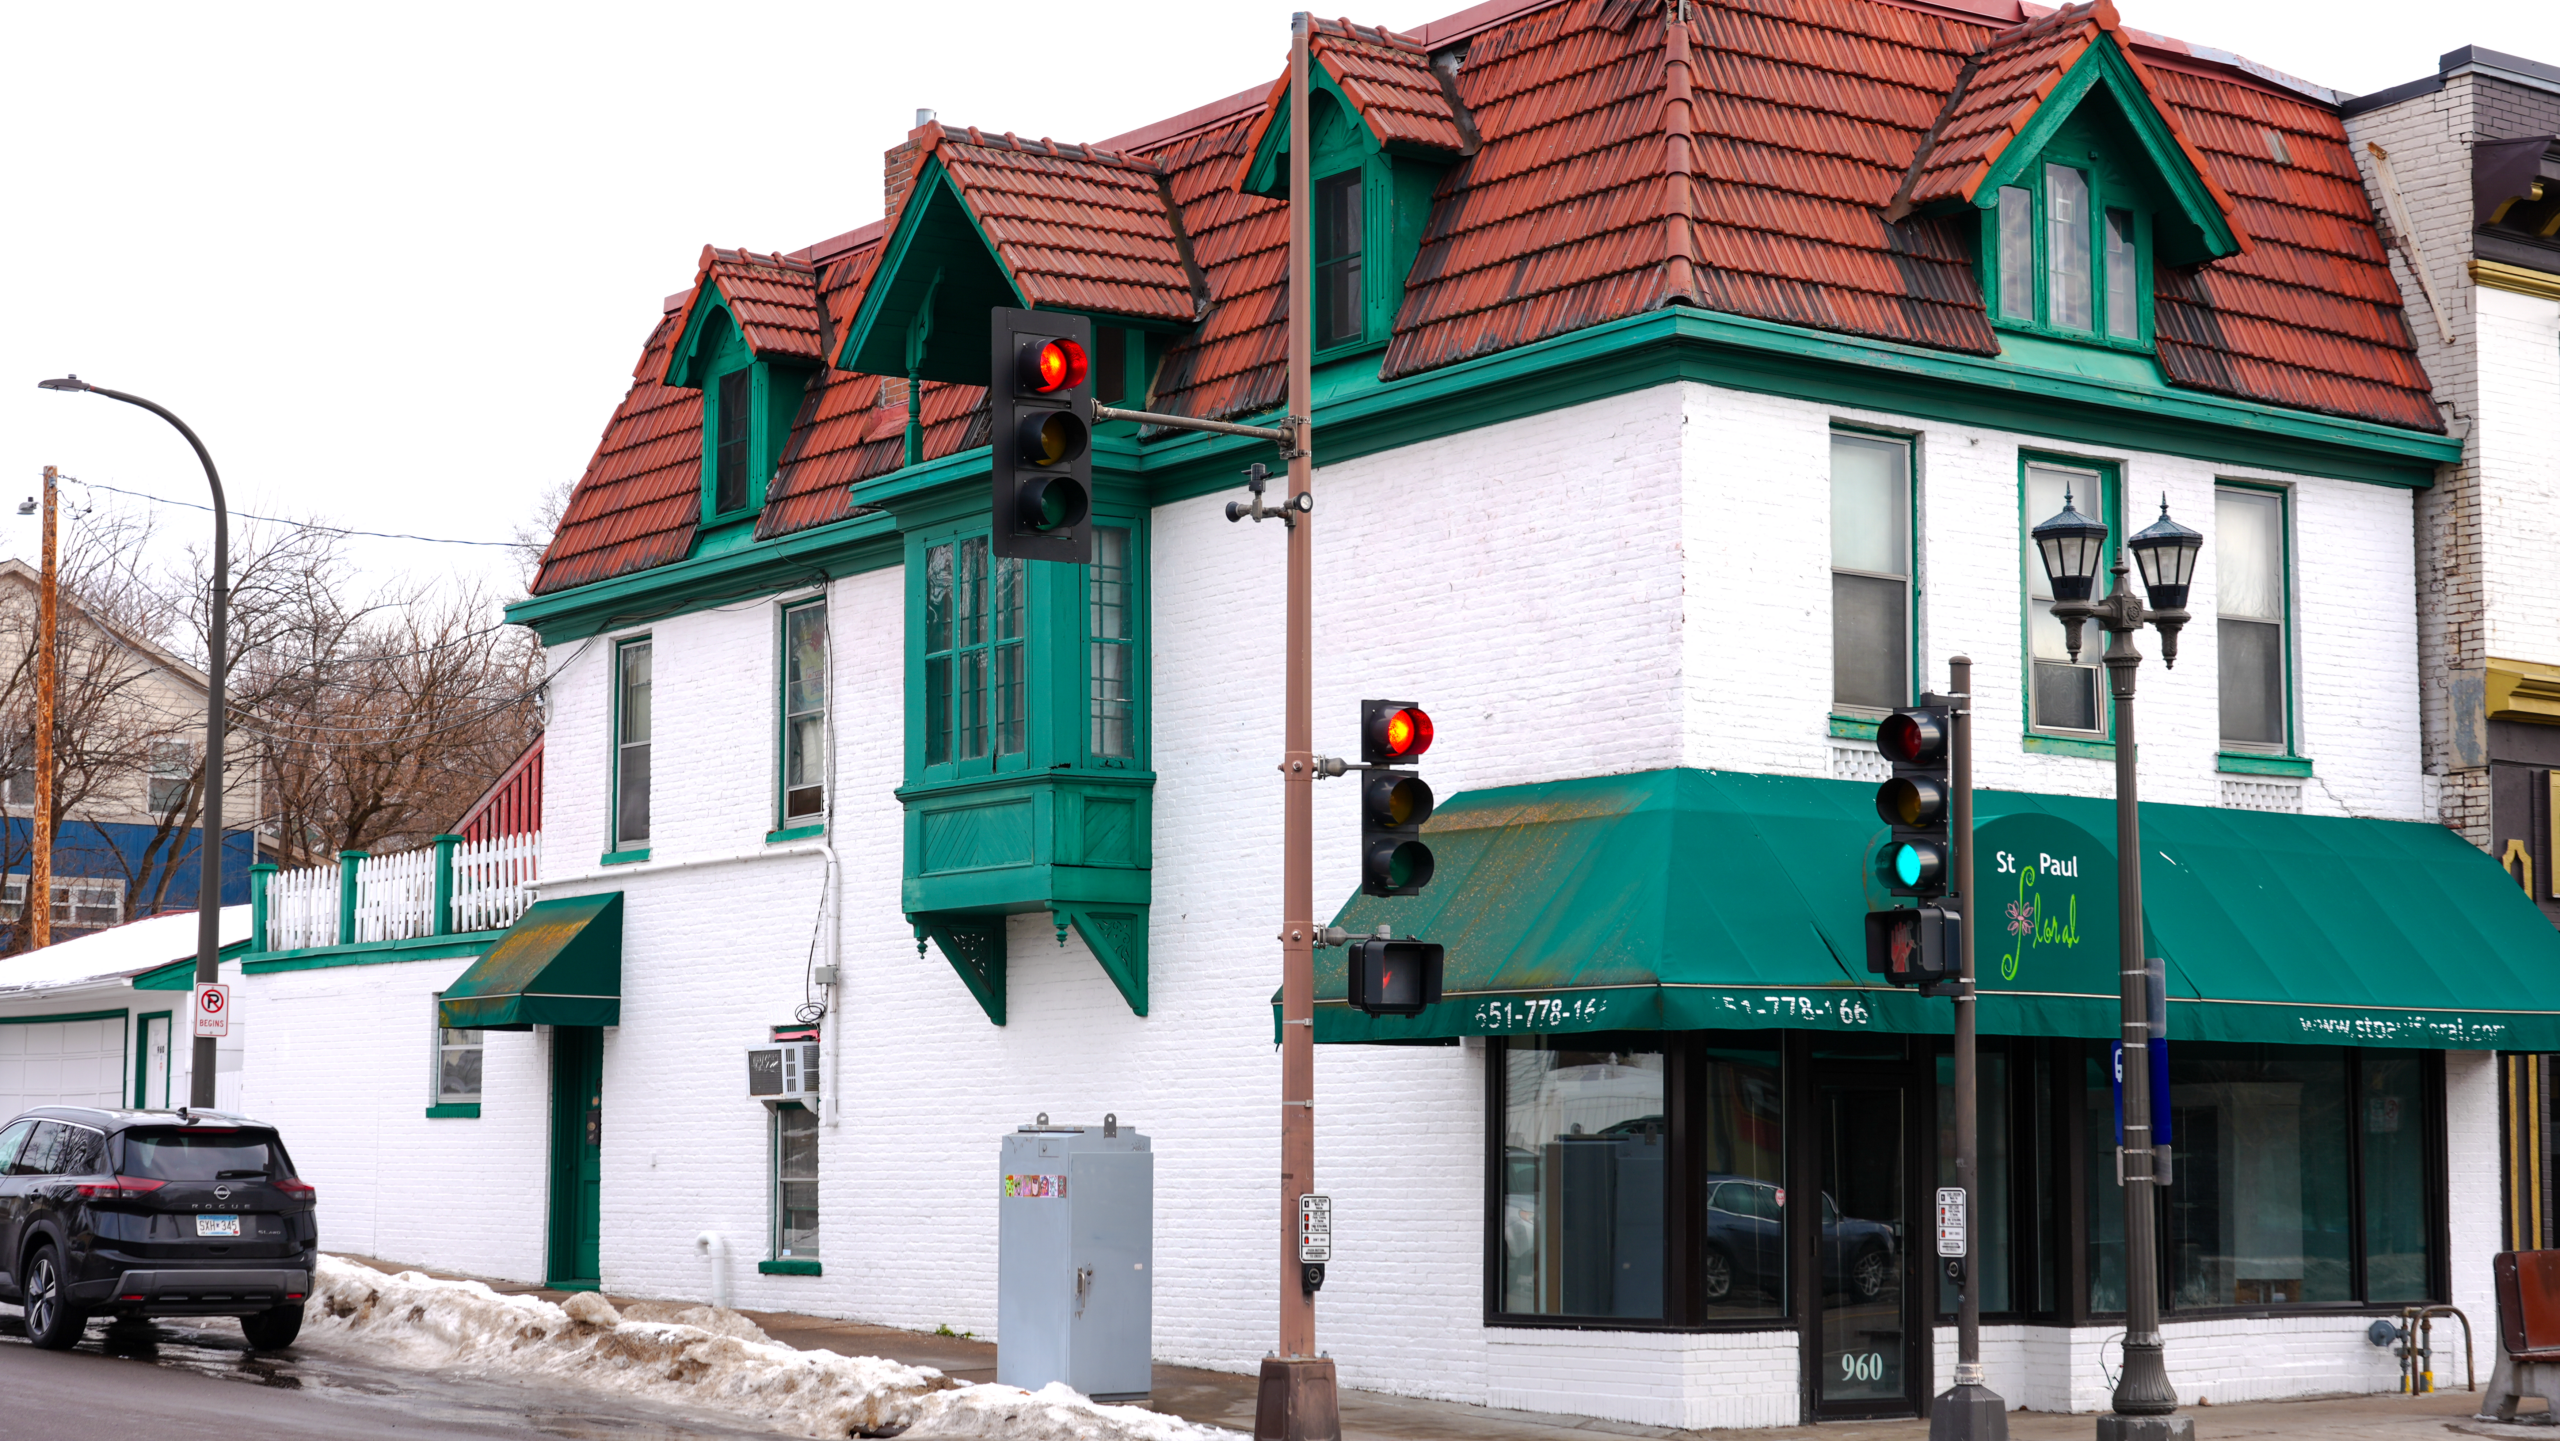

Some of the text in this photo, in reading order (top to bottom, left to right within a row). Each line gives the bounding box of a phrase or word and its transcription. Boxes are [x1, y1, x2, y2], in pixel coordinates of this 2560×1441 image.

[1996, 850, 2078, 877] St Paul
[199, 1019, 224, 1028] BEGINS
[199, 1220, 237, 1231] SXH 345
[1841, 1353, 1883, 1381] 960
